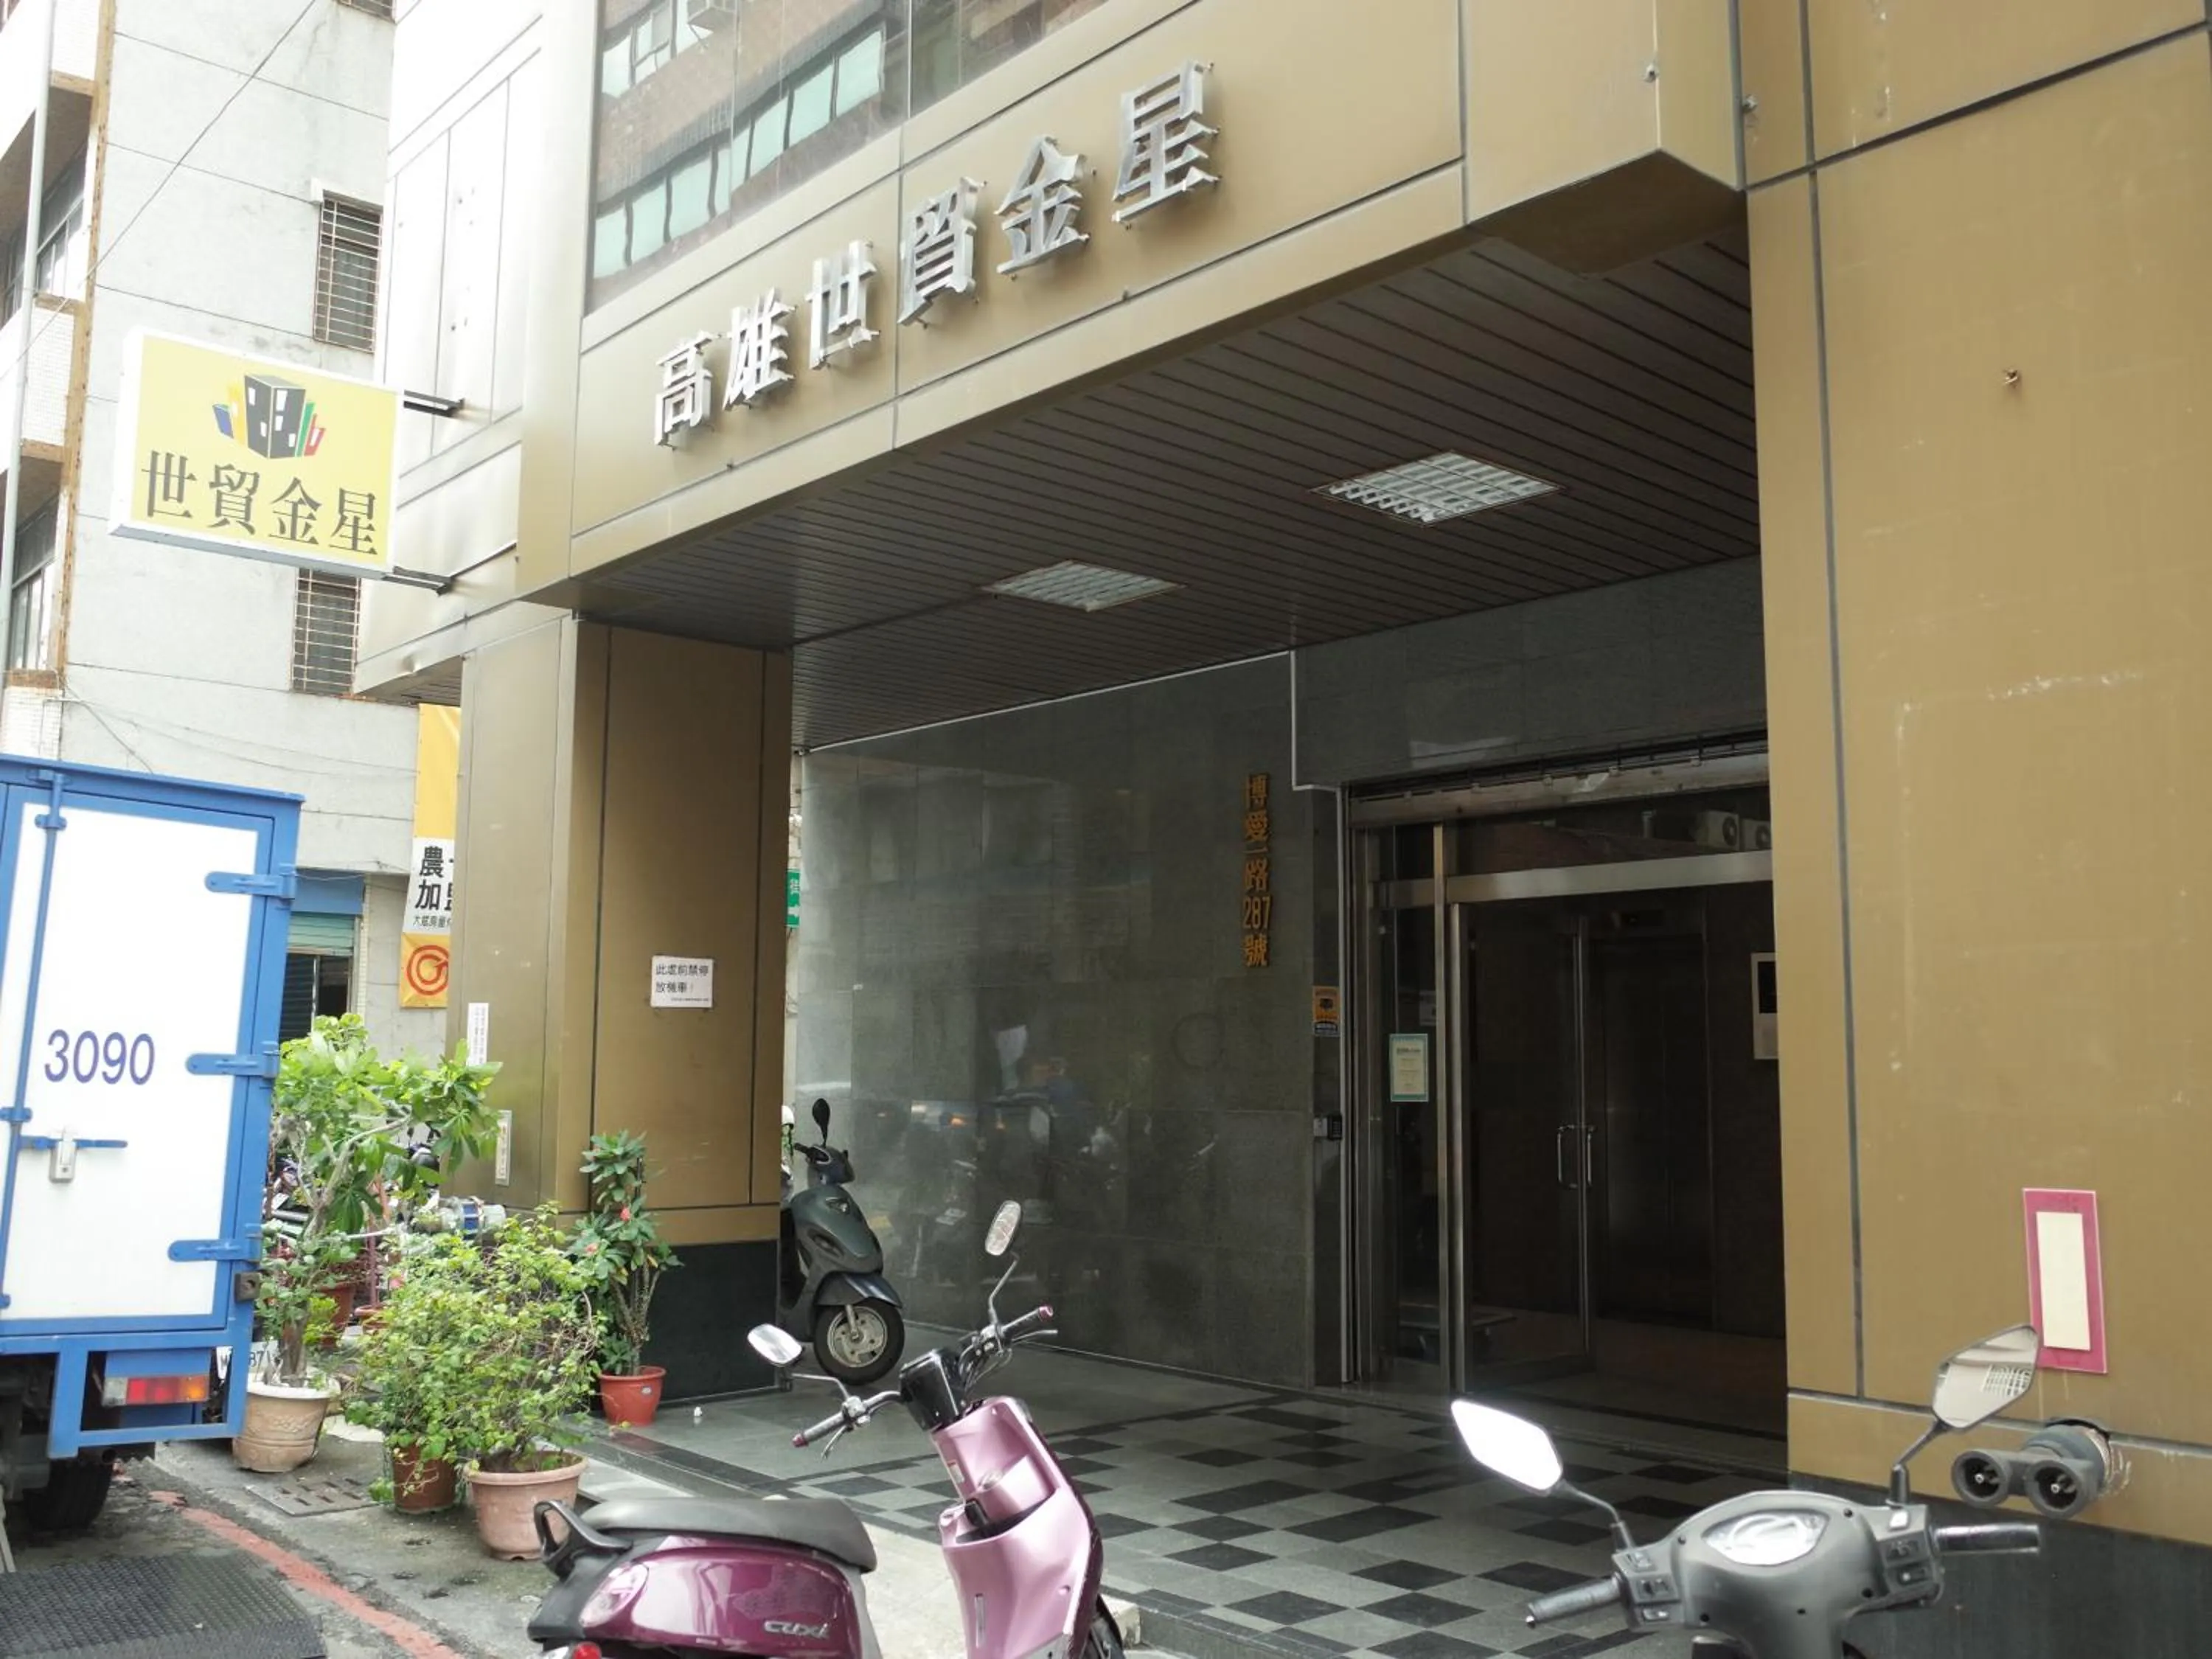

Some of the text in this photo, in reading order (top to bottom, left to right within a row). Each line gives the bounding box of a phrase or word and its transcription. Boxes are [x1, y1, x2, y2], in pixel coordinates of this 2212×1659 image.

[654, 59, 1220, 445] 高雄世貿金星
[142, 449, 379, 556] 世貿金星
[420, 846, 454, 877] 農
[45, 1029, 155, 1085] 3090
